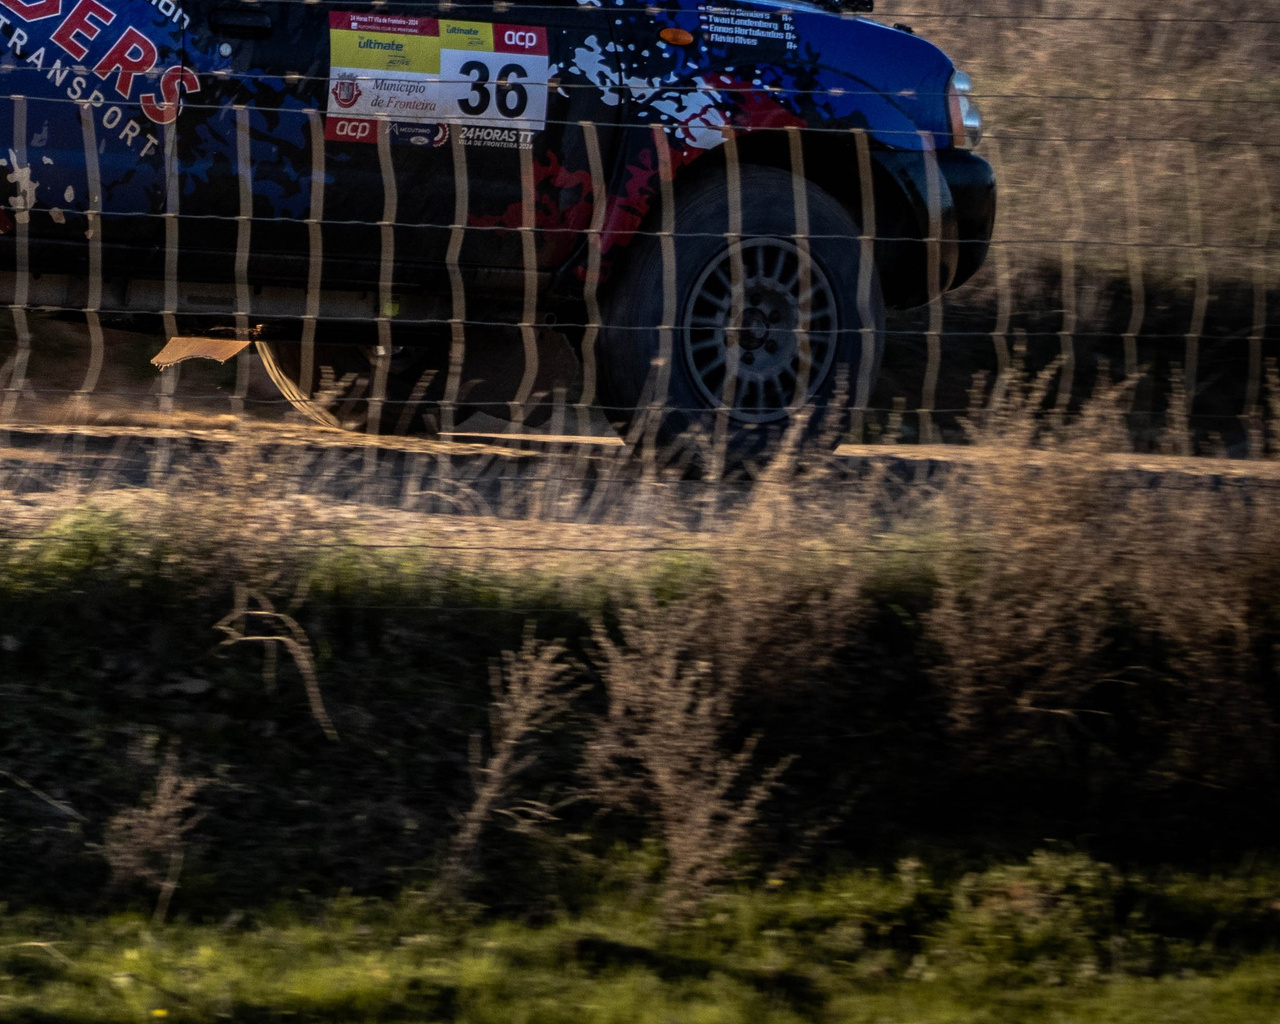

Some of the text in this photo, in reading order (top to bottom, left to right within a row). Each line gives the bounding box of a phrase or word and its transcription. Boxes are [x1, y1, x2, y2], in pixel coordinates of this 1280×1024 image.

[446, 26, 479, 35] ultimate
[358, 38, 404, 52] ultimate
[504, 31, 537, 49] acp
[457, 61, 529, 118] 36
[371, 95, 437, 111] de Fronteira
[336, 120, 370, 139] acp
[518, 131, 535, 143] TT
